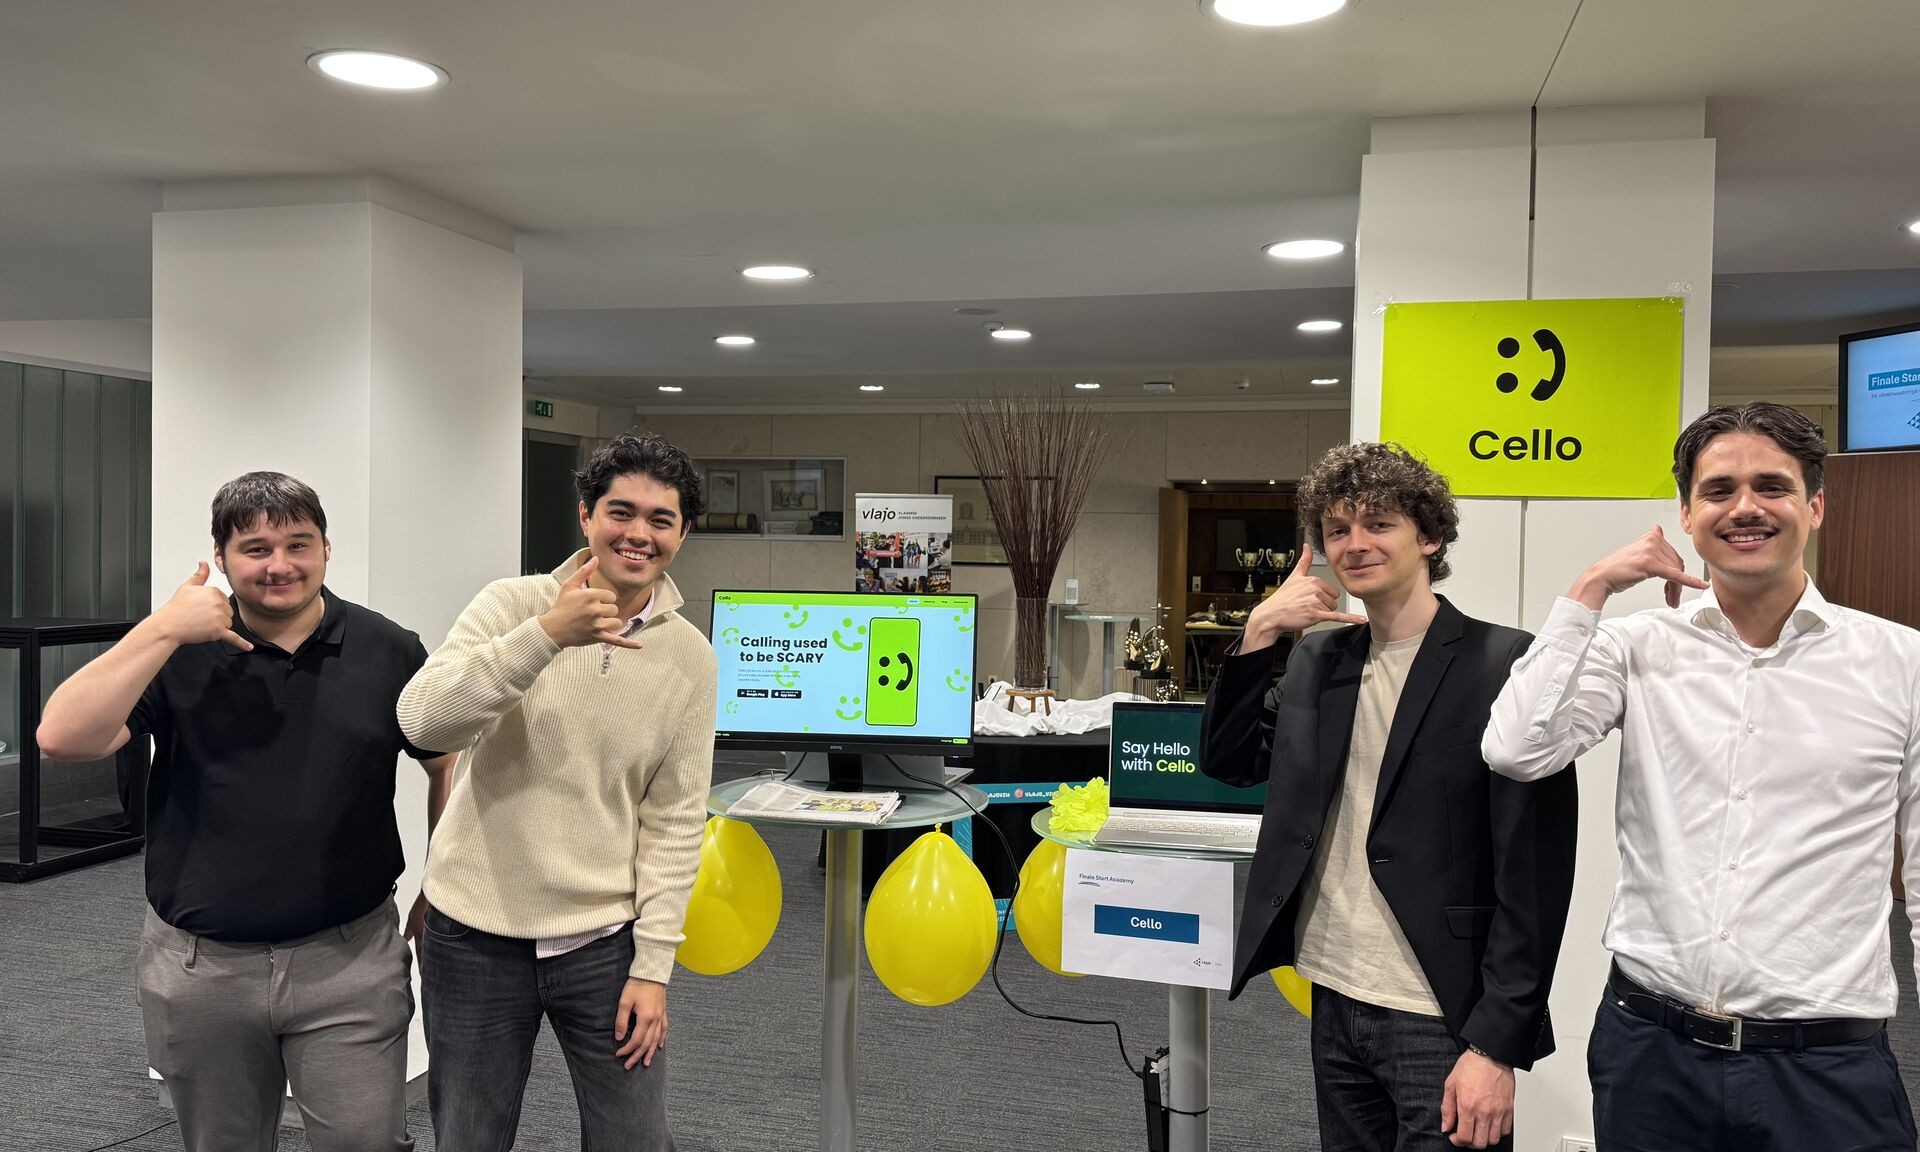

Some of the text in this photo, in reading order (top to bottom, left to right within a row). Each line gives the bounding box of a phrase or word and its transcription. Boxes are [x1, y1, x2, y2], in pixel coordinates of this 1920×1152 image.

[1871, 375, 1900, 387] Finale
[1469, 429, 1582, 461] Cello
[862, 507, 896, 523] vlajo
[740, 636, 828, 651] Calling used
[740, 652, 824, 663] to be SCARY
[1122, 741, 1190, 758] Say Hello
[1121, 757, 1196, 773] with Cello
[1109, 876, 1134, 885] Academy
[1131, 916, 1162, 930] Cello
